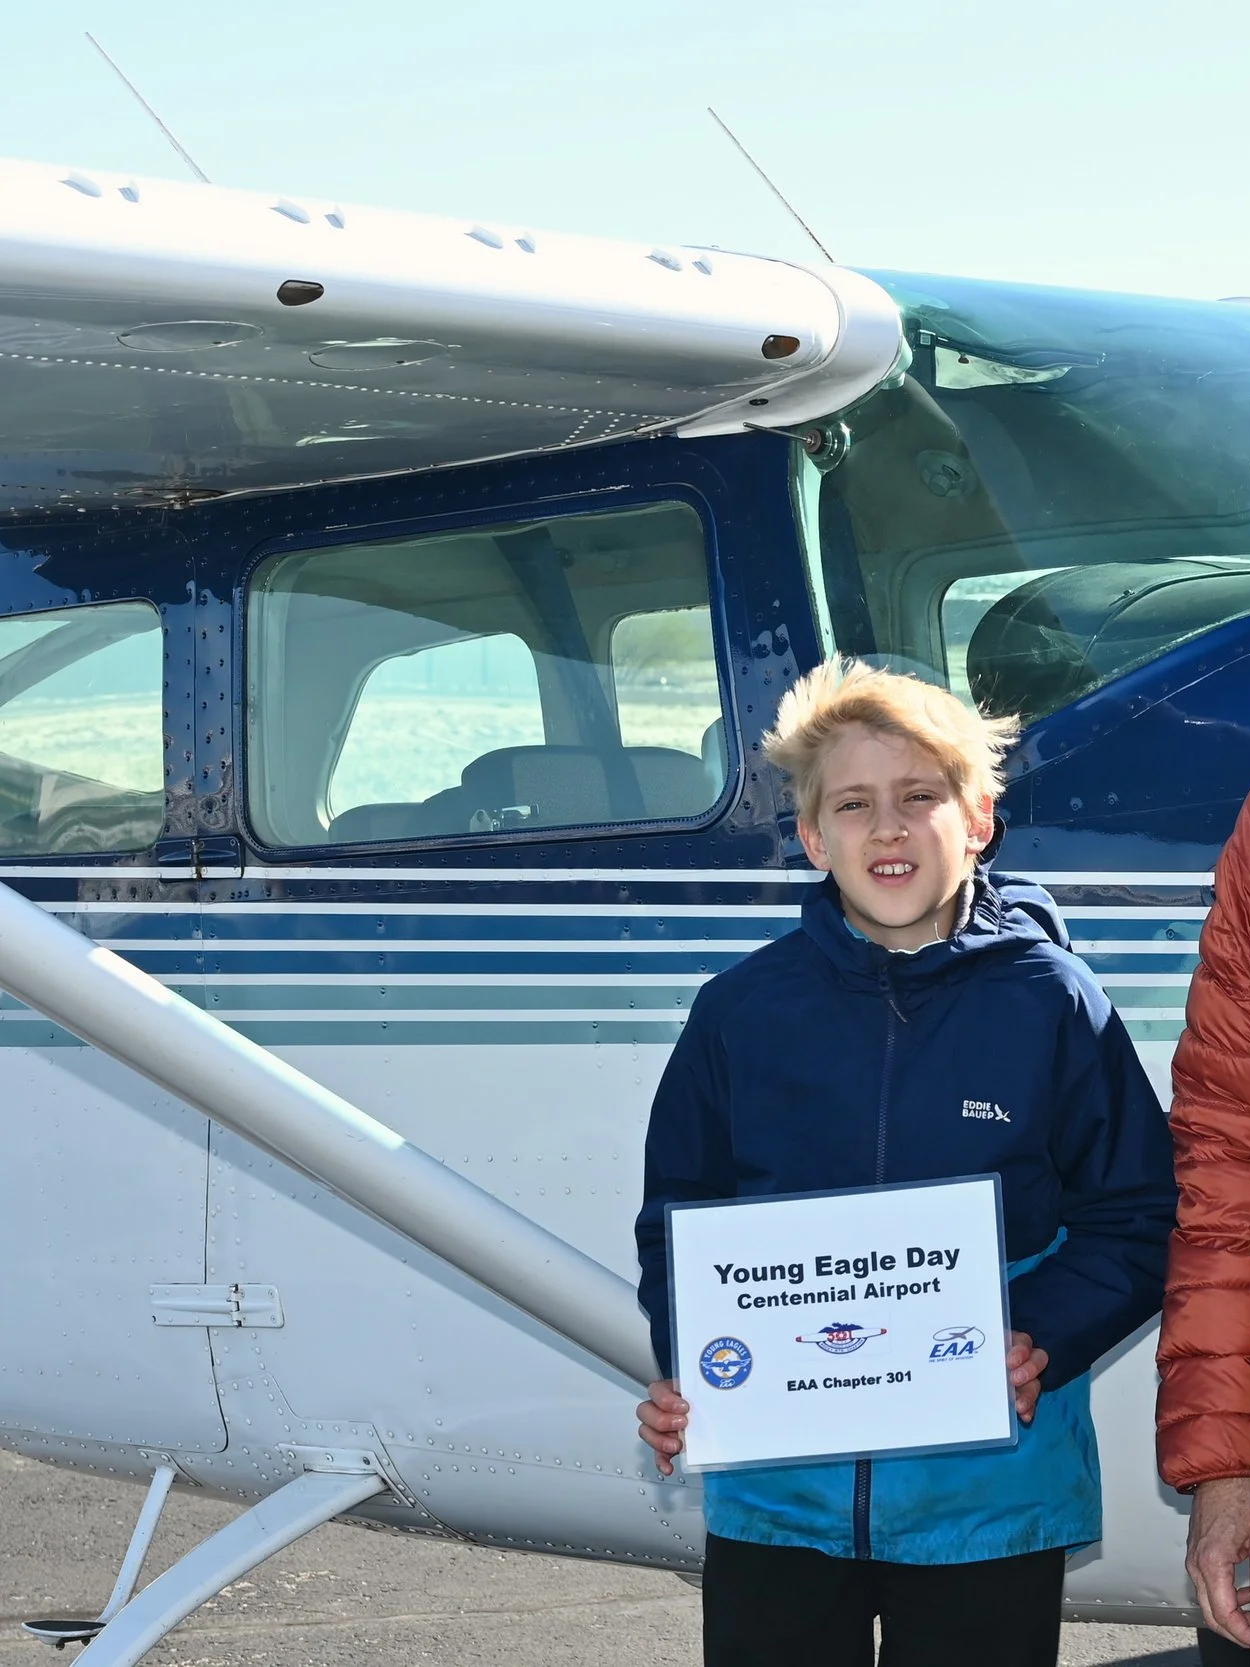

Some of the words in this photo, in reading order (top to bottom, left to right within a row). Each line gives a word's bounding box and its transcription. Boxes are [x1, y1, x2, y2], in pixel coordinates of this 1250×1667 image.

[962, 1108, 994, 1119] BAUER
[963, 1099, 991, 1111] EDDIE
[713, 1263, 804, 1285] Young
[815, 1251, 897, 1279] Eagle
[906, 1247, 960, 1270] Day
[737, 1285, 856, 1310] Centennial
[864, 1277, 941, 1300] Airport
[704, 1340, 724, 1358] YOUNG
[726, 1339, 747, 1356] EAGLES
[929, 1340, 974, 1358] EAA
[787, 1379, 818, 1391] EAA
[822, 1375, 882, 1389] Chapter
[886, 1370, 912, 1384] 301
